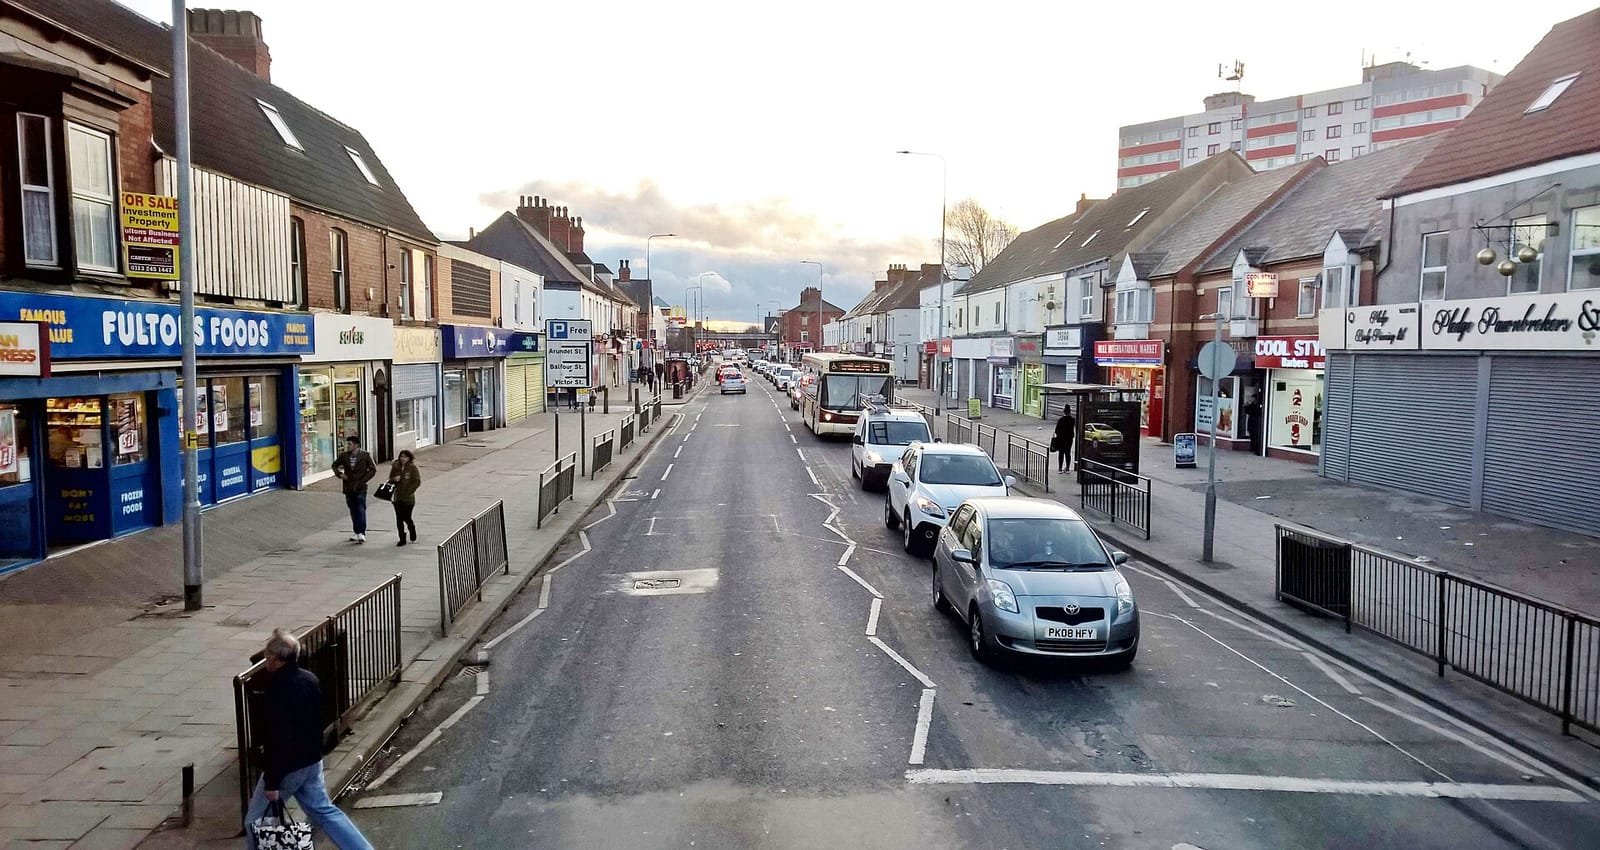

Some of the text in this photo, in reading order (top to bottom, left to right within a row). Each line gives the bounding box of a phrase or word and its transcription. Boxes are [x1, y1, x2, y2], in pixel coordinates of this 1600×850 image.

[148, 197, 179, 210] SALE
[123, 207, 176, 219] Investment
[129, 217, 170, 229] Property
[143, 236, 173, 245] Affected
[149, 230, 180, 238] Business
[20, 308, 66, 325] FAMOUS
[1432, 307, 1474, 342] Pledge
[1478, 303, 1573, 335] Pawnbrokers
[49, 328, 73, 343] ALUE
[102, 311, 268, 347] FULTOS FOODS
[553, 323, 565, 338] P
[1107, 344, 1139, 354] INTERNATIONAL
[1140, 344, 1158, 354] MARKET
[1255, 340, 1291, 356] COOL
[1281, 357, 1309, 368] Barbers
[121, 490, 143, 503] FROZEN
[122, 502, 143, 515] FOODS
[1048, 628, 1093, 638] PK08 HFY
